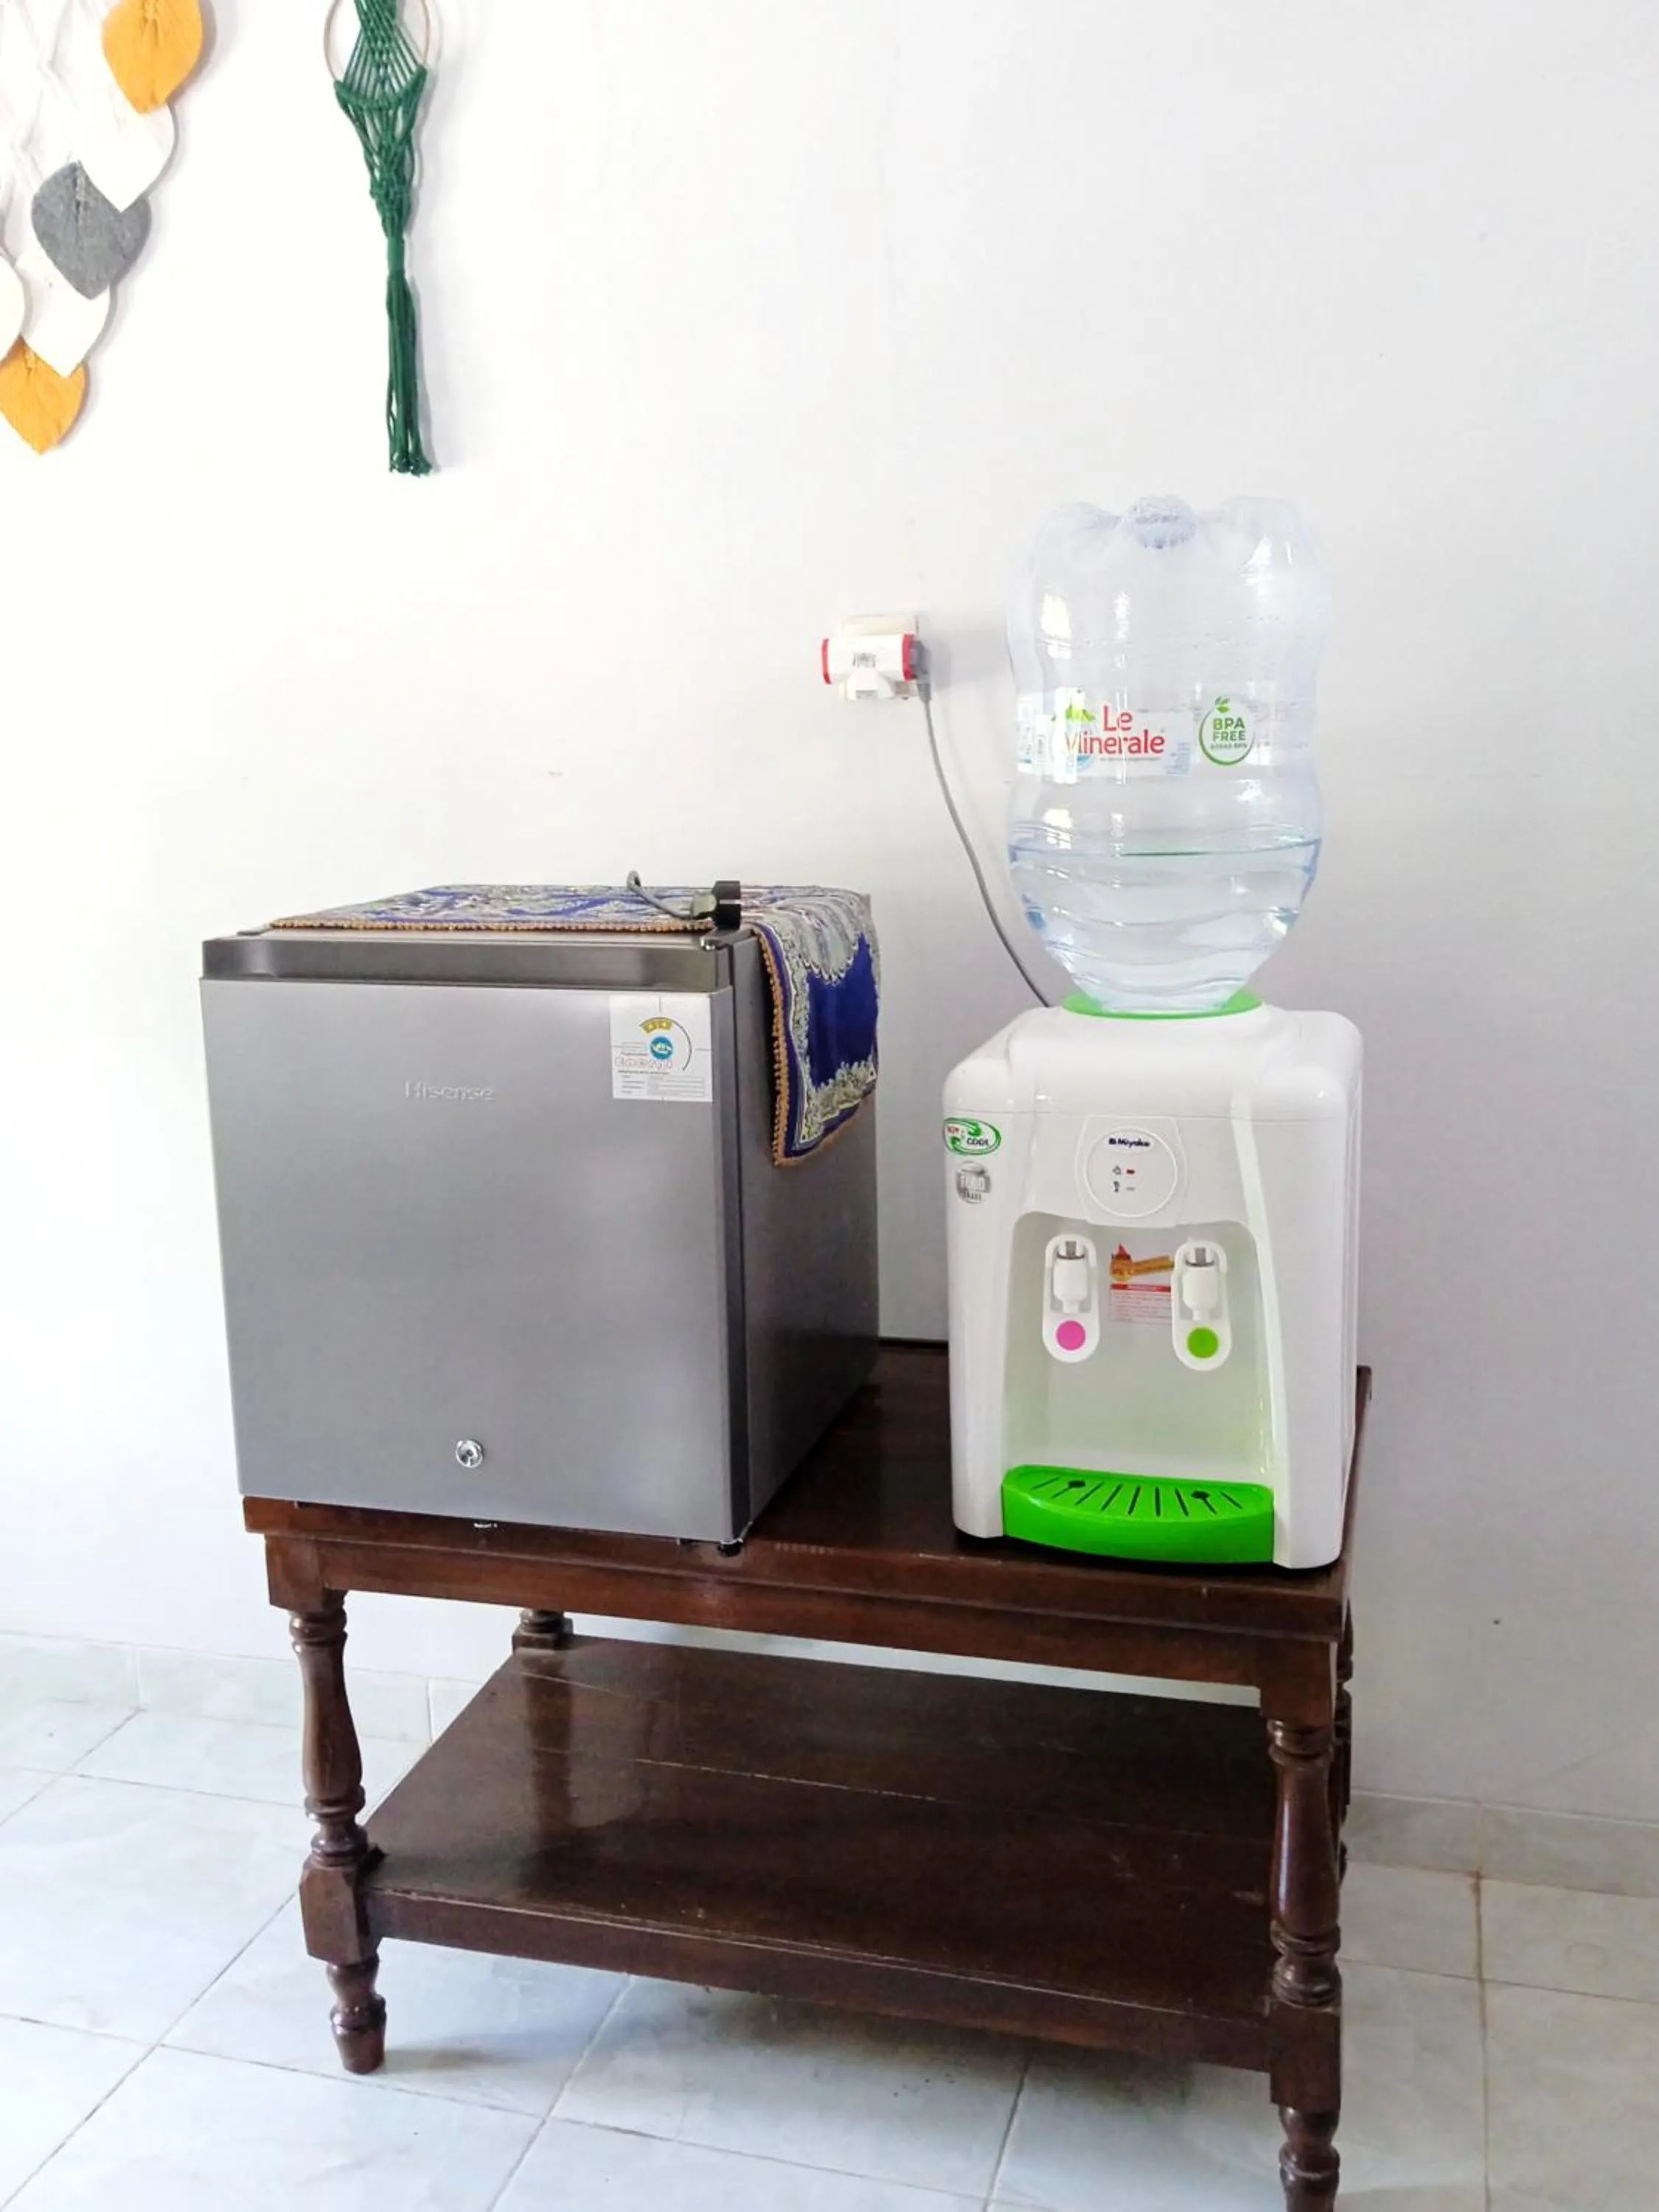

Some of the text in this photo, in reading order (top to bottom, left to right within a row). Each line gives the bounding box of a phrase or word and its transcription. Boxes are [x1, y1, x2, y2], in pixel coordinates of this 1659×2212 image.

[1103, 705, 1133, 731] Le
[1213, 717, 1245, 730] BPA
[1213, 731, 1245, 741] FREE
[404, 1080, 495, 1100] Hisense
